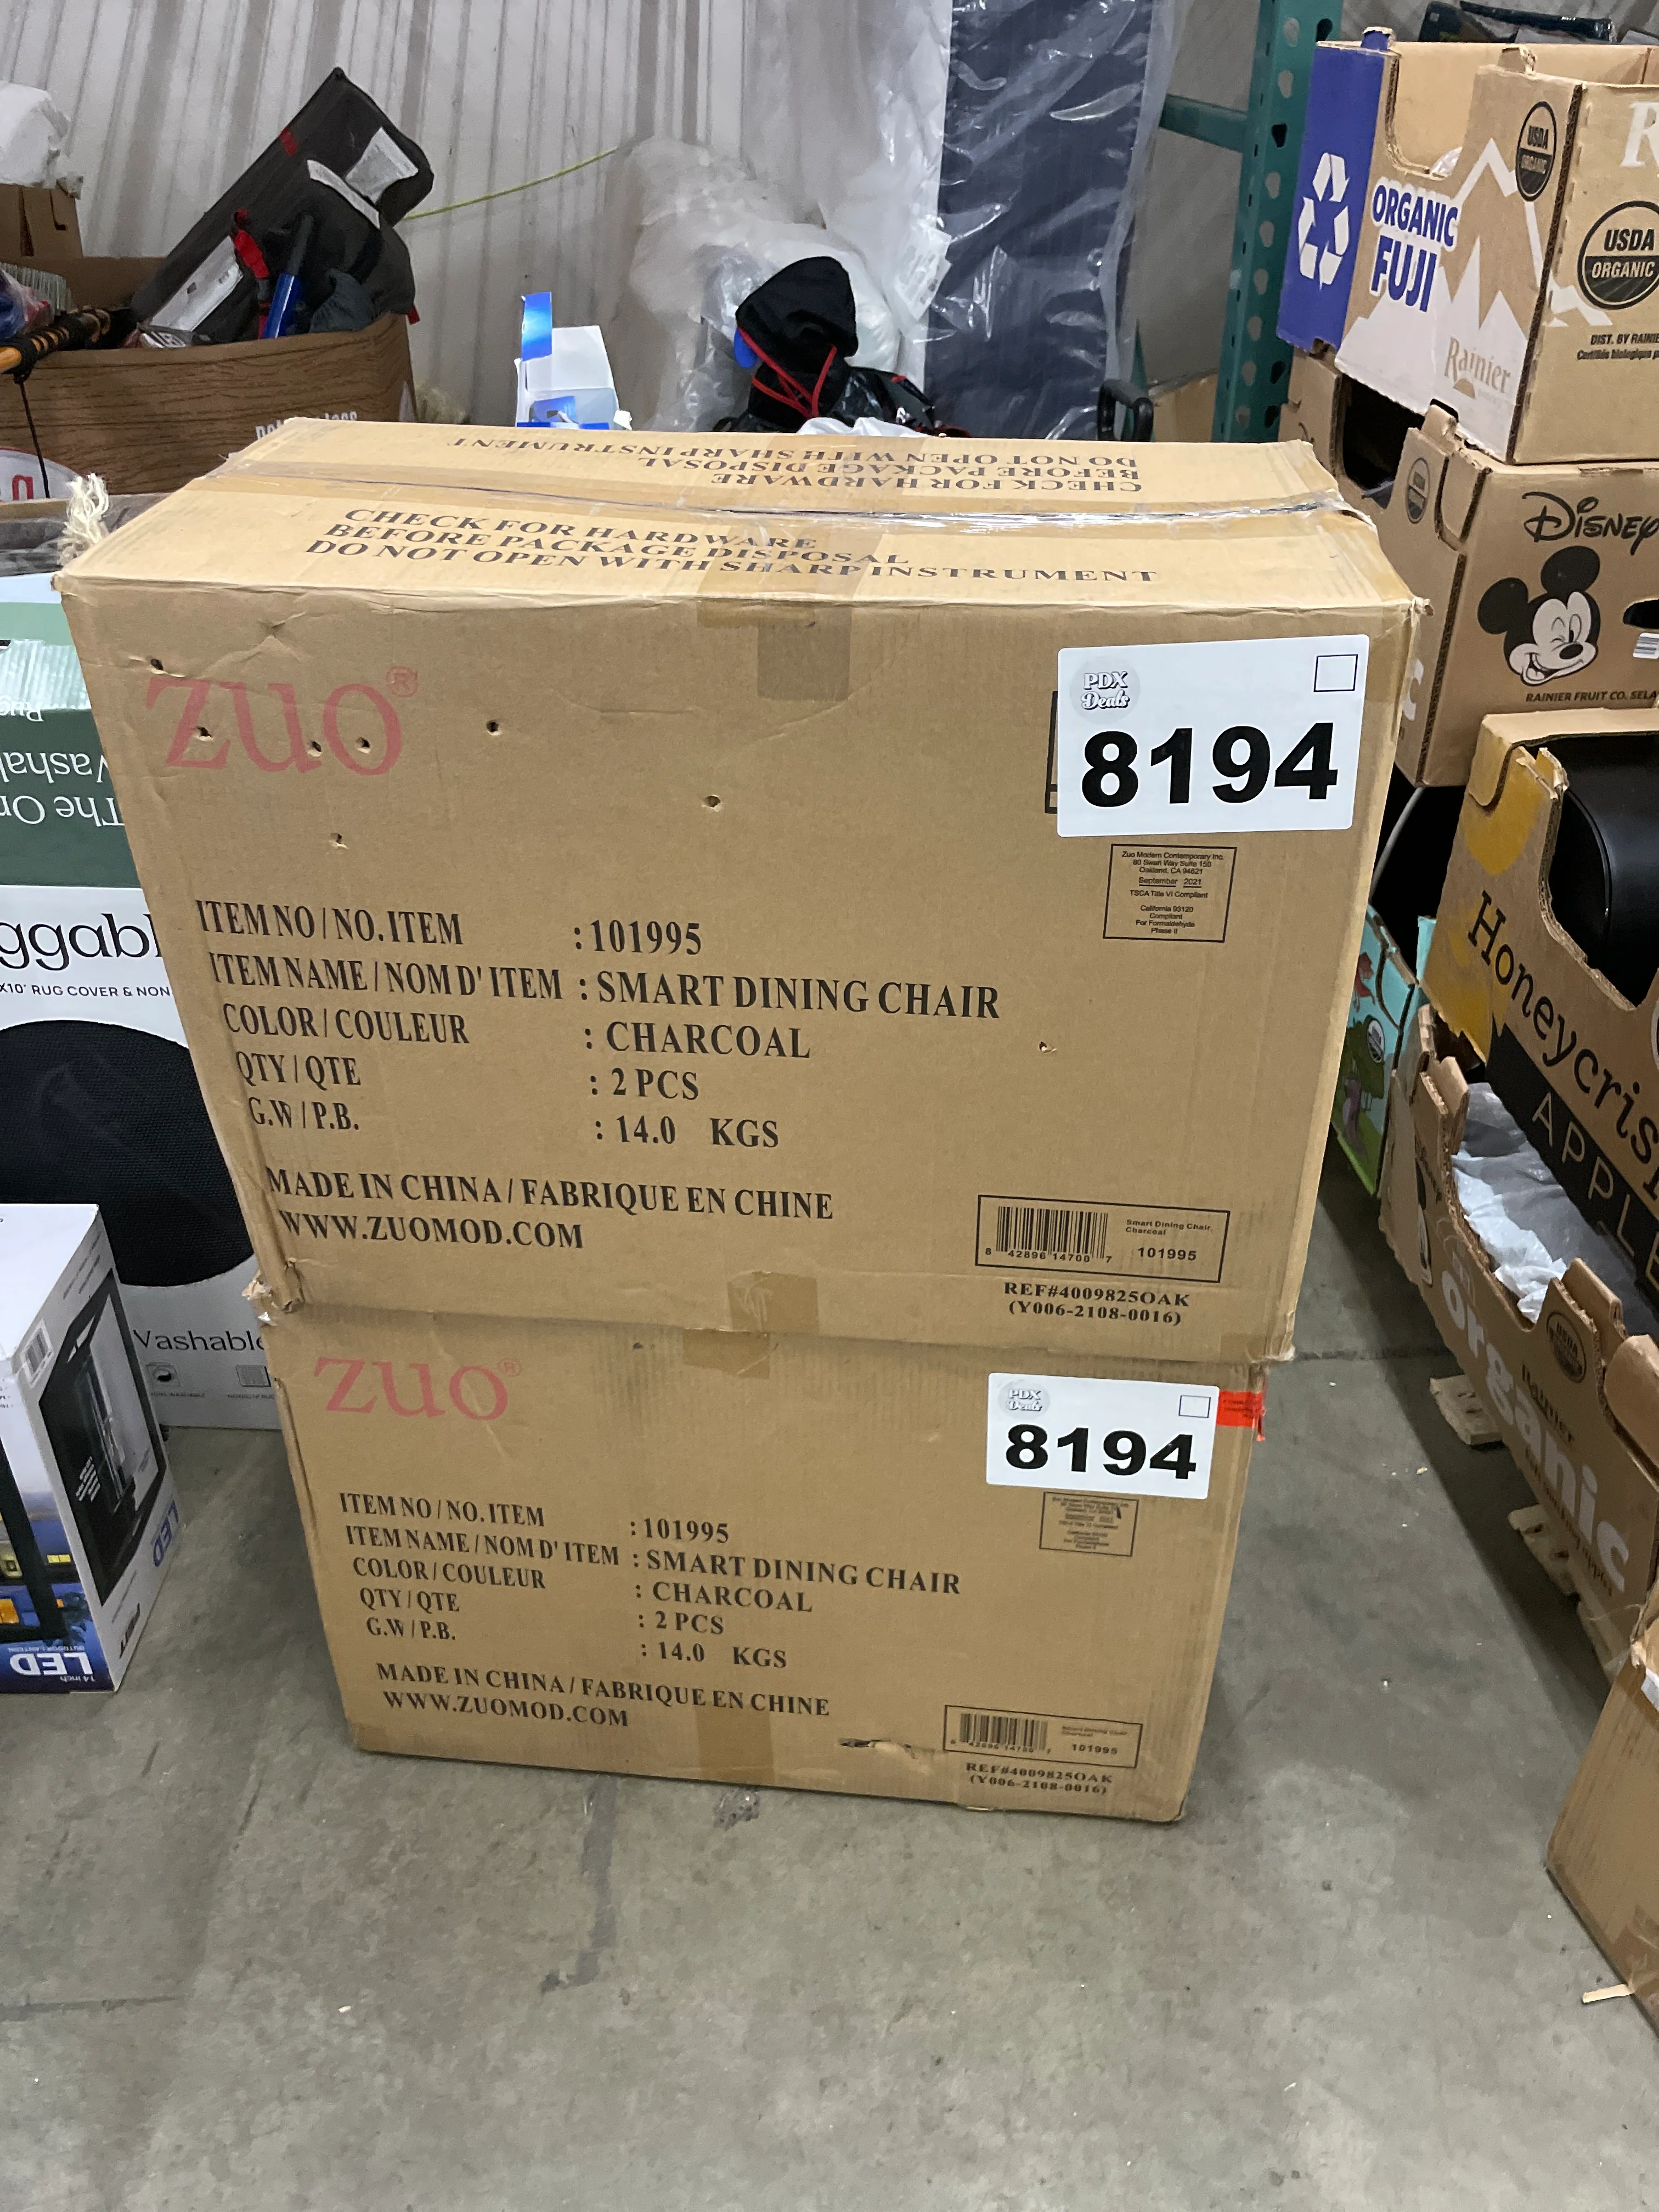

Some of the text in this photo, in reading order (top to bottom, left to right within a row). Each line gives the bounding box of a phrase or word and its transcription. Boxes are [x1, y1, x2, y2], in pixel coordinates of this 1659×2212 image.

[1373, 184, 1459, 247] ORGANIC
[1604, 228, 1655, 252] USDA
[1372, 235, 1437, 313] FUJI
[1592, 261, 1655, 279] ORGANIC
[1616, 333, 1630, 345] BY
[1444, 336, 1511, 394] Rainier
[449, 437, 1136, 468] DO NOT OPEN WITH SHARP INSTRUMENT
[639, 454, 1139, 479] BEFORE PACKAGE DISPOSAL
[711, 471, 1142, 492] CHECK FOR HARDWARE
[324, 523, 909, 565] BEFORE PACKAGE DISPOSAL
[345, 509, 817, 550] CHECK FOR HARDWARE
[305, 540, 1157, 582] DO NOT OPEN WITH SHARP INSTRUMENT
[1084, 671, 1128, 690] PDX
[1526, 692, 1572, 702] RAINIER
[1573, 691, 1609, 702] FRUIT
[1081, 689, 1130, 710] Deals
[0, 751, 108, 784] asha
[1081, 722, 1339, 808] 8194
[53, 795, 125, 827] The
[195, 899, 270, 936] ITEM
[272, 905, 315, 938] NO
[387, 911, 464, 945] ITEM
[590, 919, 701, 955] 101995
[31, 984, 64, 996] RUG
[67, 985, 119, 997] COVER
[208, 951, 281, 987] ITEM
[281, 957, 368, 991] NAME
[383, 962, 452, 995] NOM
[488, 967, 563, 1000] ITEM
[597, 970, 724, 1007] SMART
[732, 976, 869, 1012] DINING
[878, 981, 1000, 1019] CHAIR
[335, 1009, 470, 1044] COULEUR
[606, 1021, 811, 1059] CHARCOAL
[1467, 890, 1659, 1201] Honeycris
[305, 1055, 362, 1091] QTE
[611, 1067, 627, 1096] 2
[634, 1068, 699, 1101] PCS
[616, 1115, 675, 1144] 14.0
[709, 1118, 778, 1148] KGS
[263, 1163, 833, 1220] MADE IN CHINA FABRIQUE EN CHINE
[276, 1208, 583, 1249] WWW.ZUOMOD.COM
[1125, 1227, 1166, 1235] Charcoal
[1126, 1218, 1211, 1231] Smart Dining Chair
[1138, 1247, 1197, 1261] 101995
[1004, 1282, 1189, 1307] REF#4009825OAK
[1008, 1301, 1182, 1326] (Y006-2108-0016)
[1006, 1400, 1043, 1412] Deals
[1008, 1388, 1041, 1401] PDX
[1440, 1269, 1630, 1593] organic
[1006, 1424, 1197, 1480] 8194
[340, 1492, 396, 1516] ITEM
[400, 1497, 432, 1519] NO
[488, 1503, 544, 1527] ITEM
[644, 1517, 729, 1543] 101995
[346, 1525, 960, 1595] ITEM NAME NOM ITEM SMART DINING CHAIR
[442, 1563, 546, 1589] COULEUR
[652, 1581, 812, 1612] CHARCOAL
[416, 1590, 460, 1615] QTE
[675, 1612, 724, 1635] PCS
[10, 1651, 94, 1675] LED
[658, 1641, 705, 1662] 14.0
[733, 1646, 786, 1668] KGS
[376, 1662, 830, 1716] MADE CHINA FABRIQUE CHINE
[382, 1691, 628, 1727] WWW.ZUOMOD.COM
[1071, 1743, 1118, 1756] 101995
